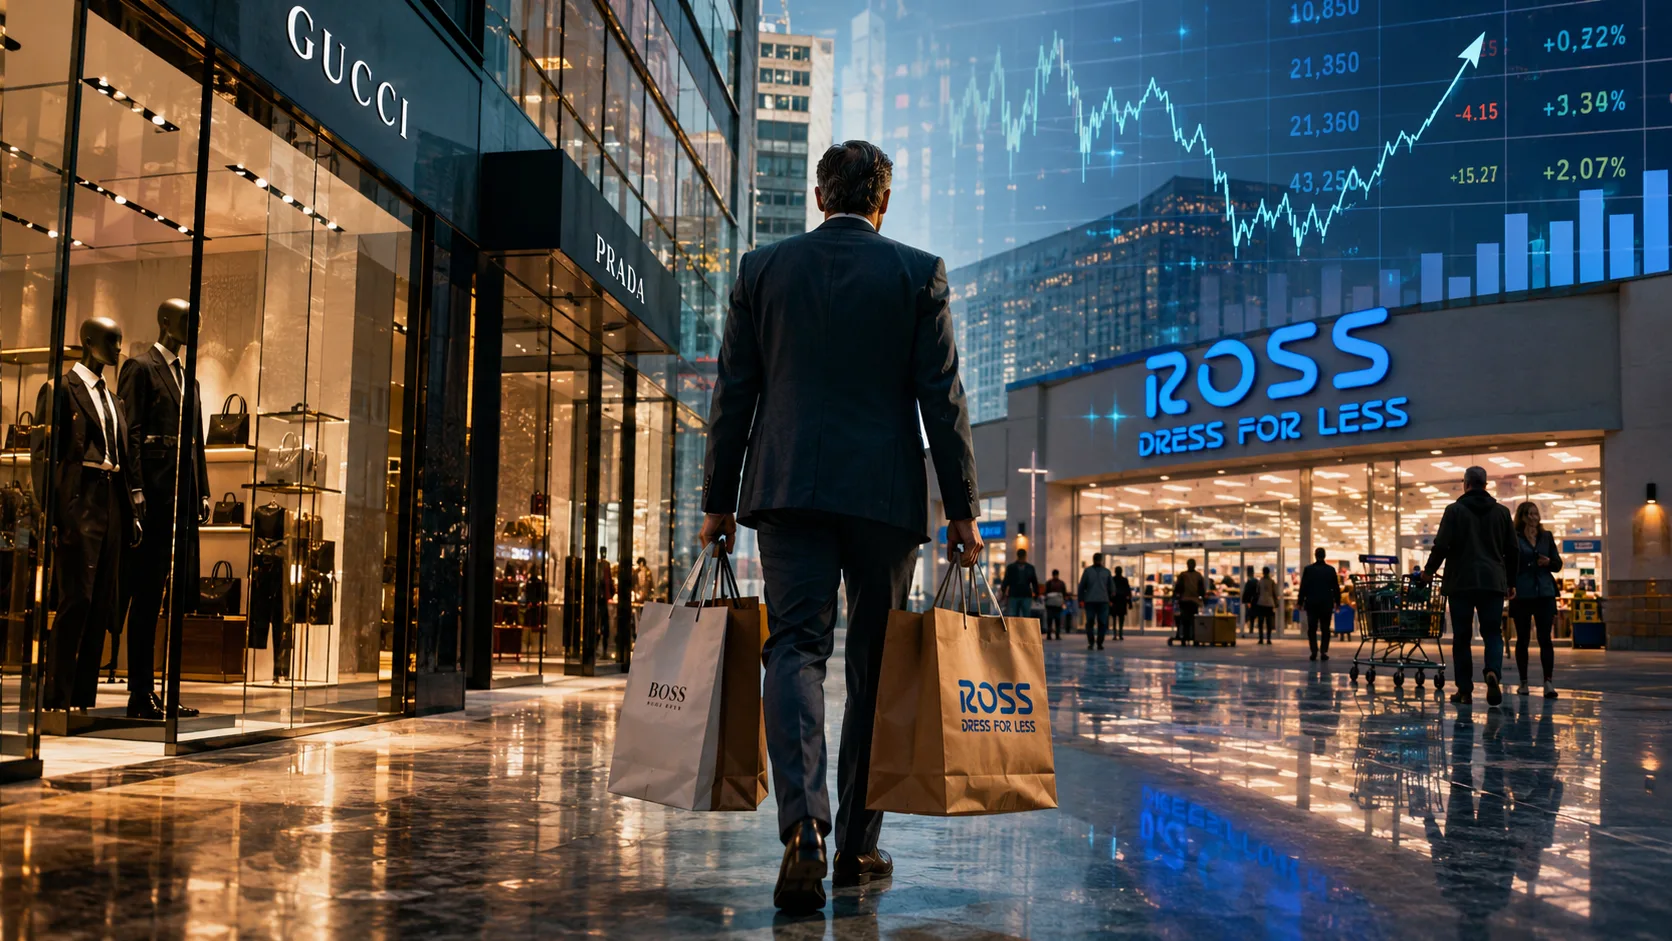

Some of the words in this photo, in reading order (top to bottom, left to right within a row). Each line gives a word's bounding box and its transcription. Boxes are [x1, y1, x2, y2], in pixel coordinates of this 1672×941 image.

[287, 5, 409, 139] GUCCI
[596, 233, 645, 304] PRADA
[1145, 306, 1391, 419] ROSS
[1138, 420, 1225, 458] DRESS
[1237, 411, 1301, 445] FOR
[1317, 396, 1410, 436] LESS
[648, 681, 687, 702] BOSS
[958, 679, 1033, 714] ROSS
[961, 719, 991, 732] DRESS
[994, 720, 1012, 732] FOR
[1014, 720, 1036, 733] LESS
